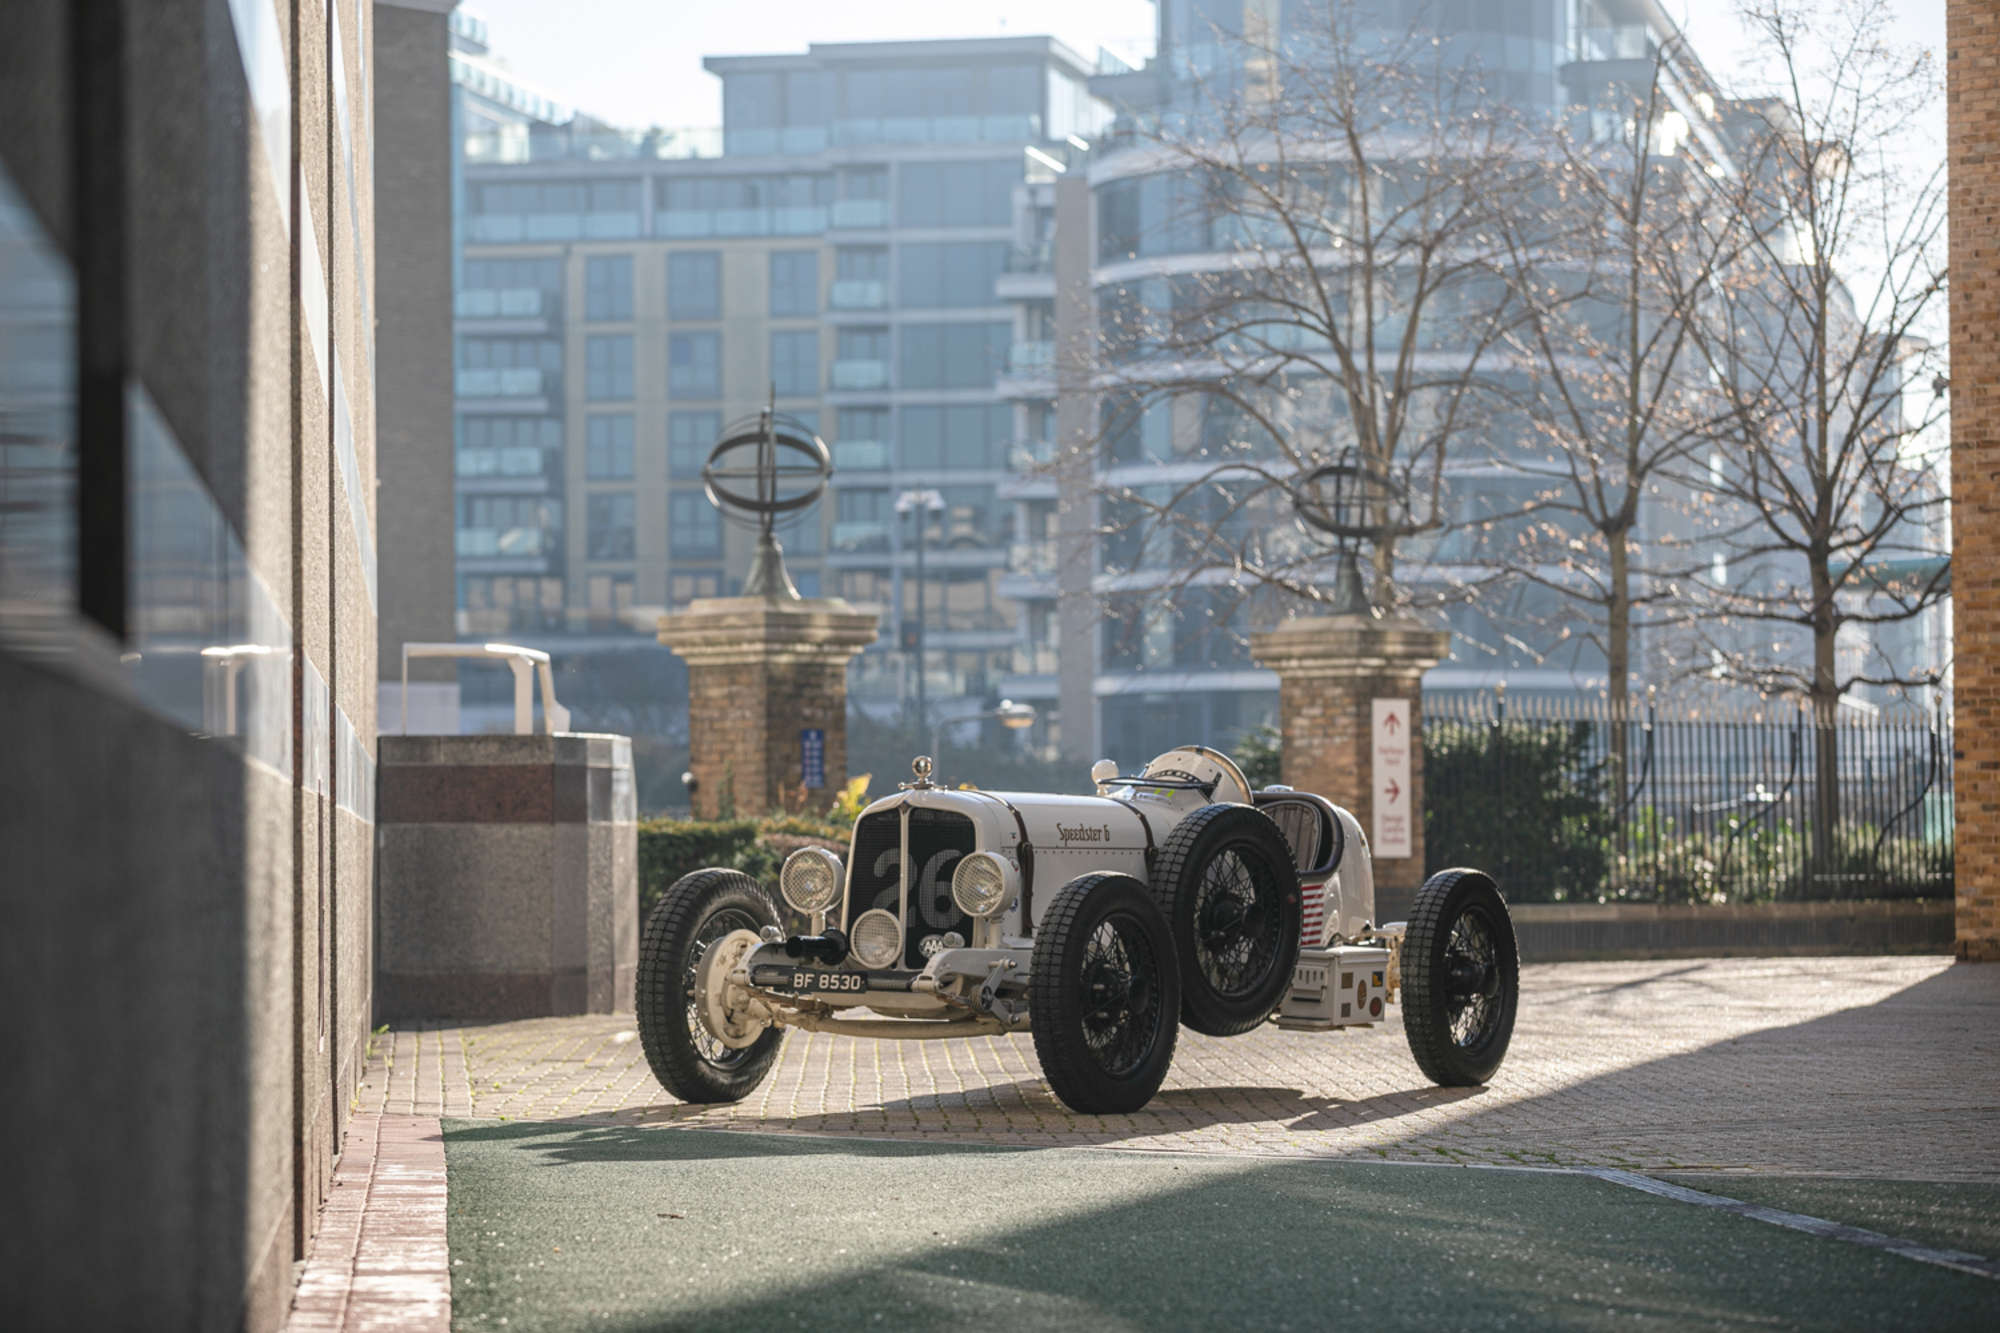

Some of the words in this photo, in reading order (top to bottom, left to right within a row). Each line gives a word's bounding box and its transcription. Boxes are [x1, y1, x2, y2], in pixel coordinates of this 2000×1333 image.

[1056, 823, 1102, 847] Speedster
[1103, 823, 1110, 841] 6
[873, 848, 964, 929] 26
[924, 940, 944, 953] AAA
[793, 973, 815, 988] BF
[819, 974, 861, 990] 8530
